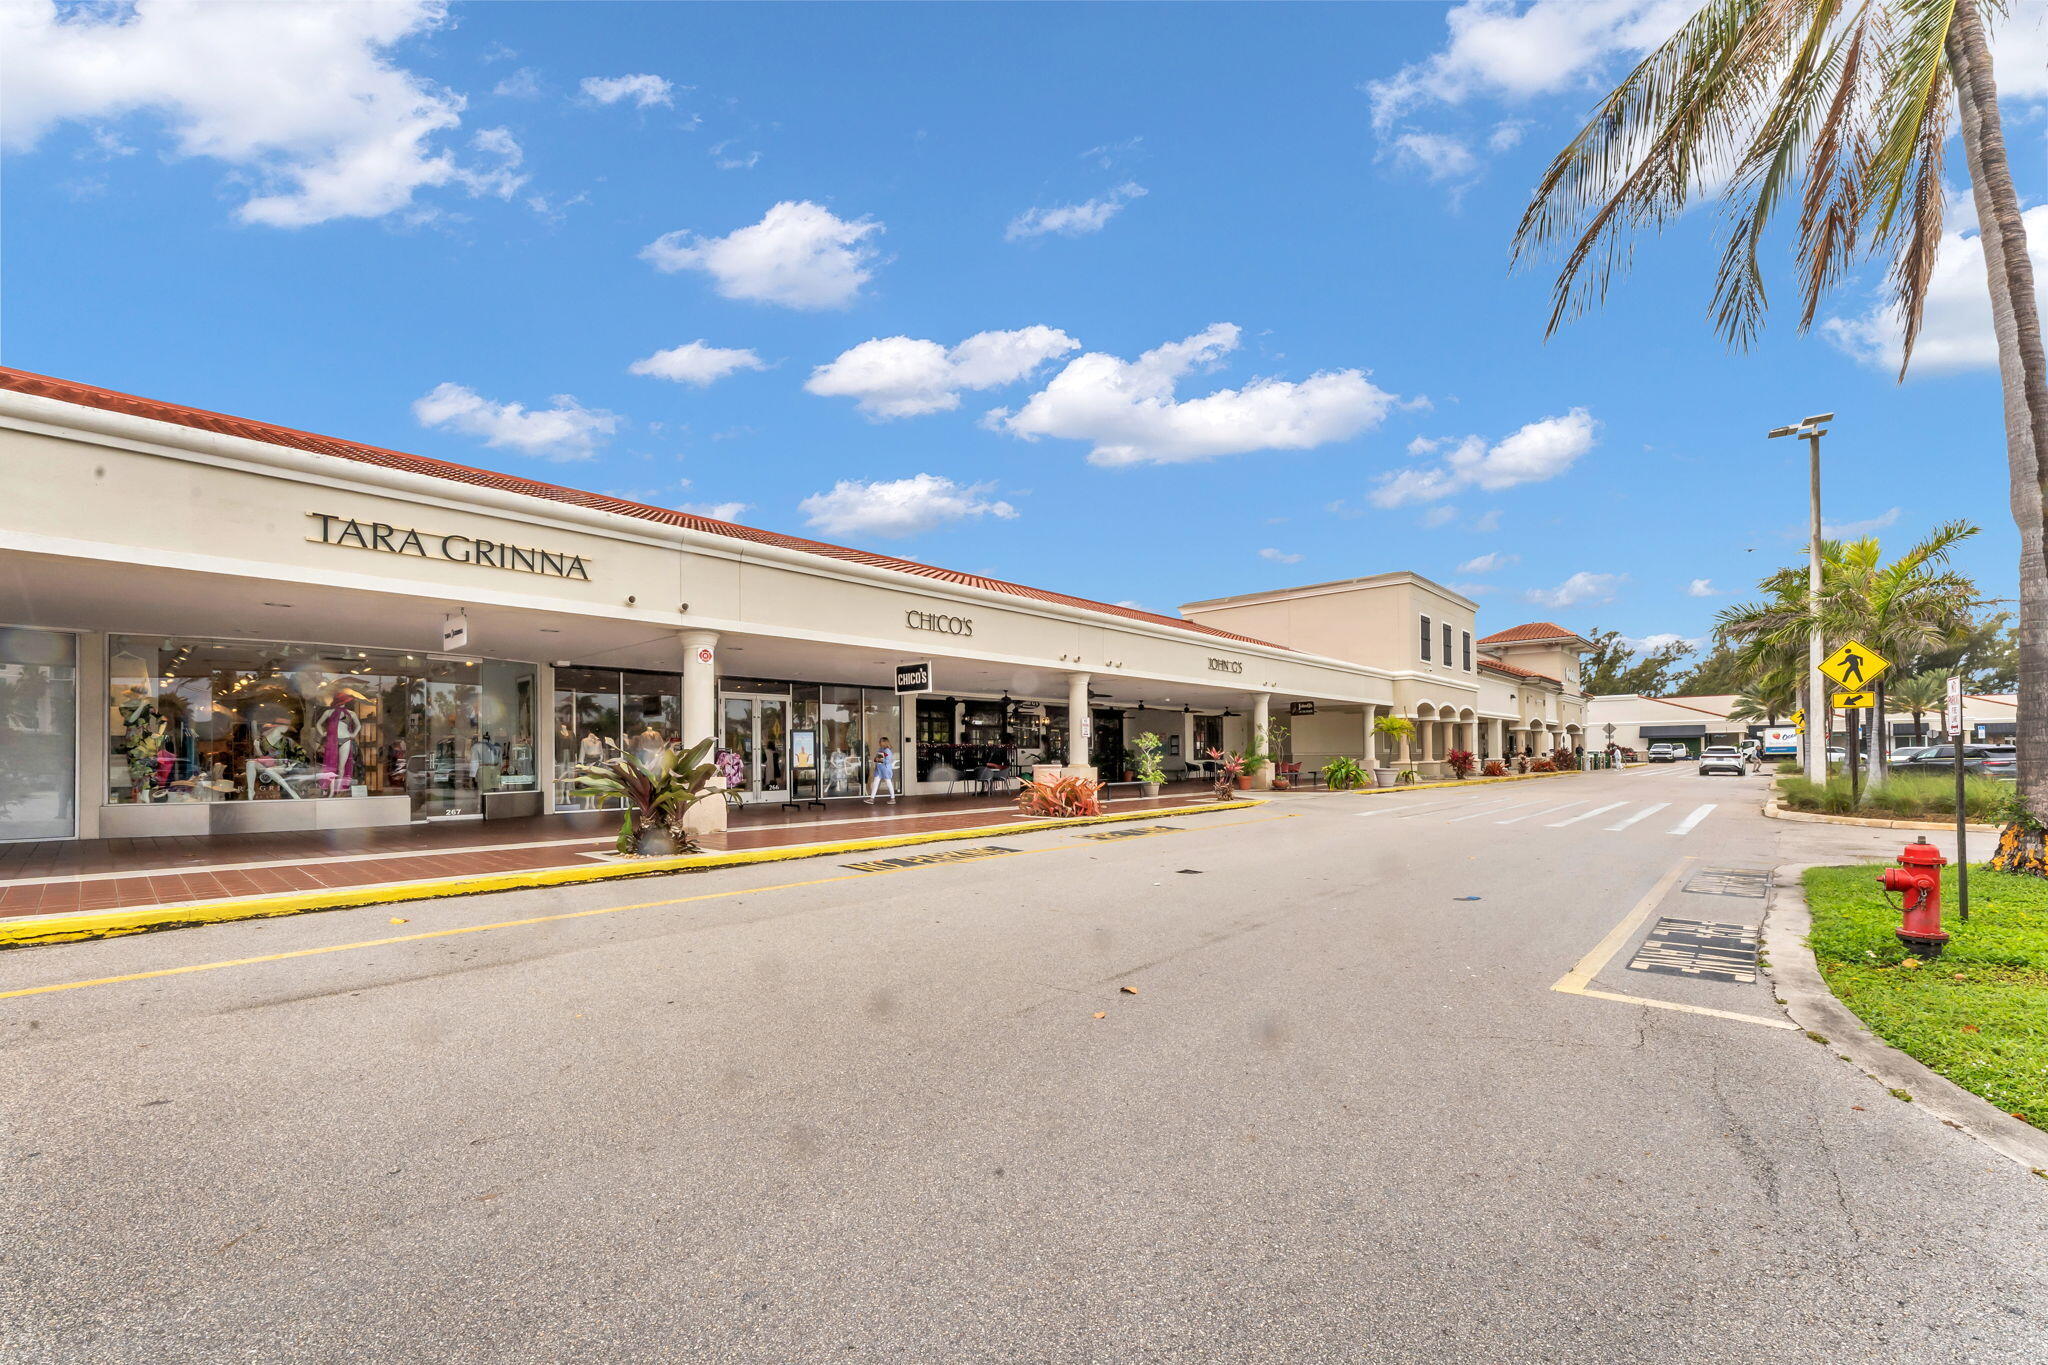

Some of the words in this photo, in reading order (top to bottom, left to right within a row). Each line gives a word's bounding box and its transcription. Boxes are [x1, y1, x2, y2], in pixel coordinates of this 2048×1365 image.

[313, 513, 426, 557] TARA
[442, 535, 588, 580] GRINNA
[907, 610, 973, 636] CHICO'S
[1208, 658, 1229, 671] JOHN
[897, 668, 927, 685] CHICO'S
[445, 808, 461, 816] 267
